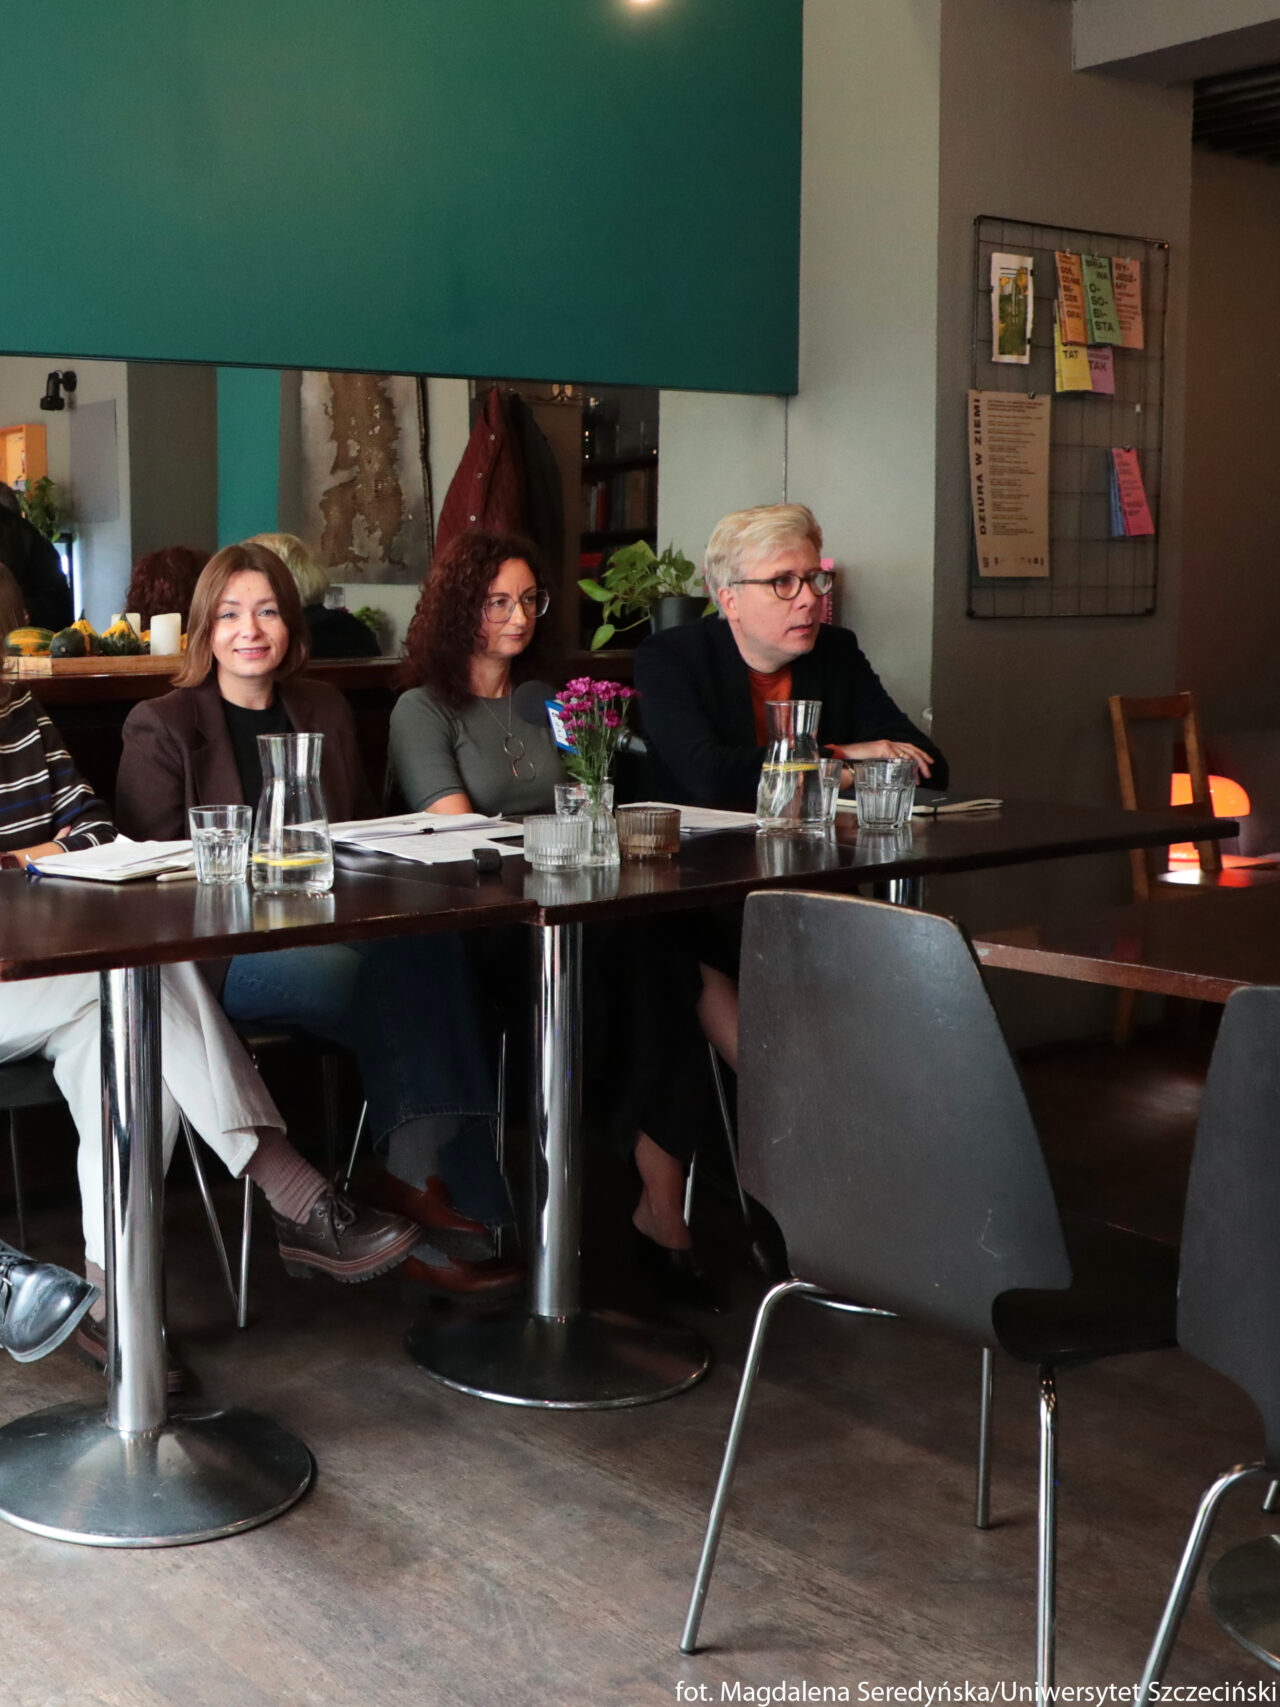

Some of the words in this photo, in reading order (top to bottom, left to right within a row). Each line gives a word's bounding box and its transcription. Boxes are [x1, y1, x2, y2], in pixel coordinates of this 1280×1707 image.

[1095, 321, 1114, 332] STA
[973, 398, 982, 445] ZIEMI
[975, 452, 983, 466] W
[976, 473, 987, 535] DZIURA
